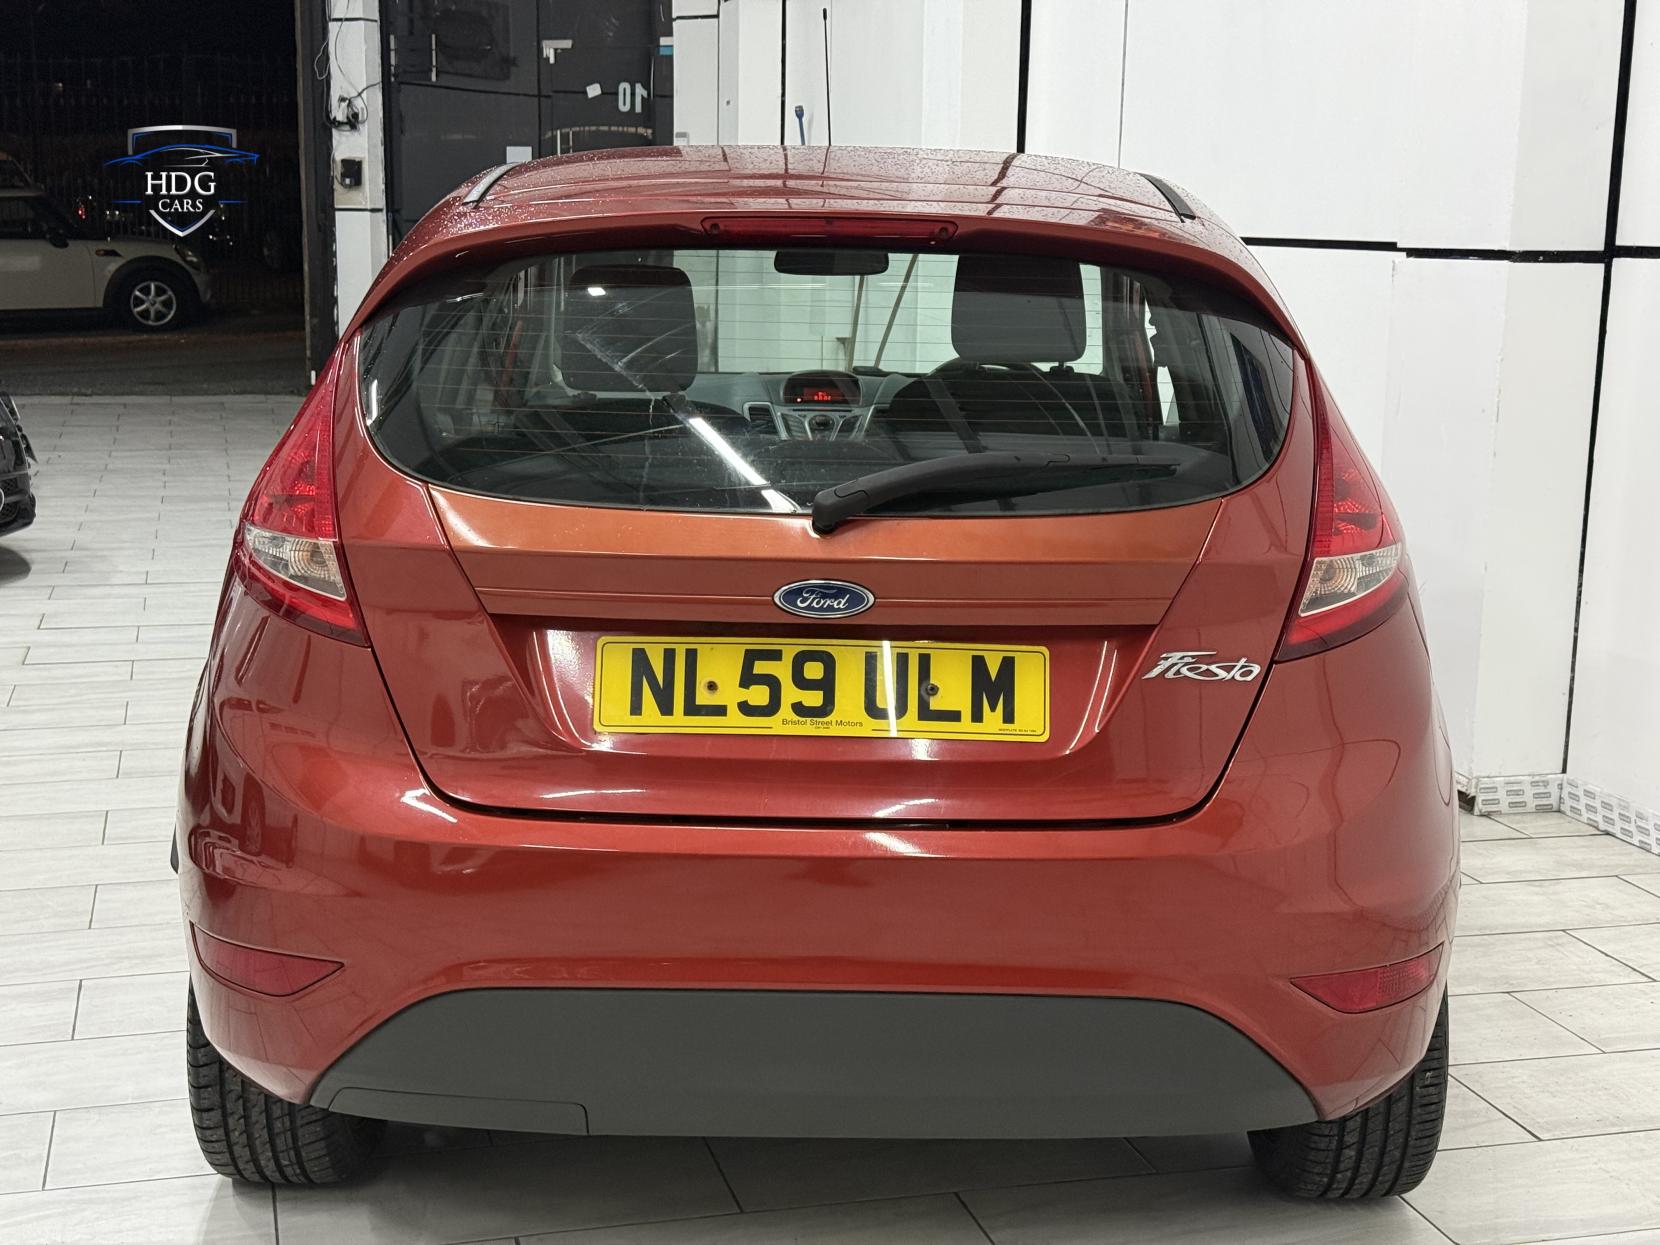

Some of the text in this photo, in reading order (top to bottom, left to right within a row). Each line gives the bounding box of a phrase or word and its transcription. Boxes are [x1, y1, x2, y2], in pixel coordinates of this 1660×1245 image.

[797, 587, 850, 609] Ford
[1141, 651, 1261, 681] Fiesta
[629, 647, 1016, 725] NL59 ULM
[781, 718, 808, 727] Bristol
[809, 718, 833, 727] Street
[835, 719, 864, 728] Motors
